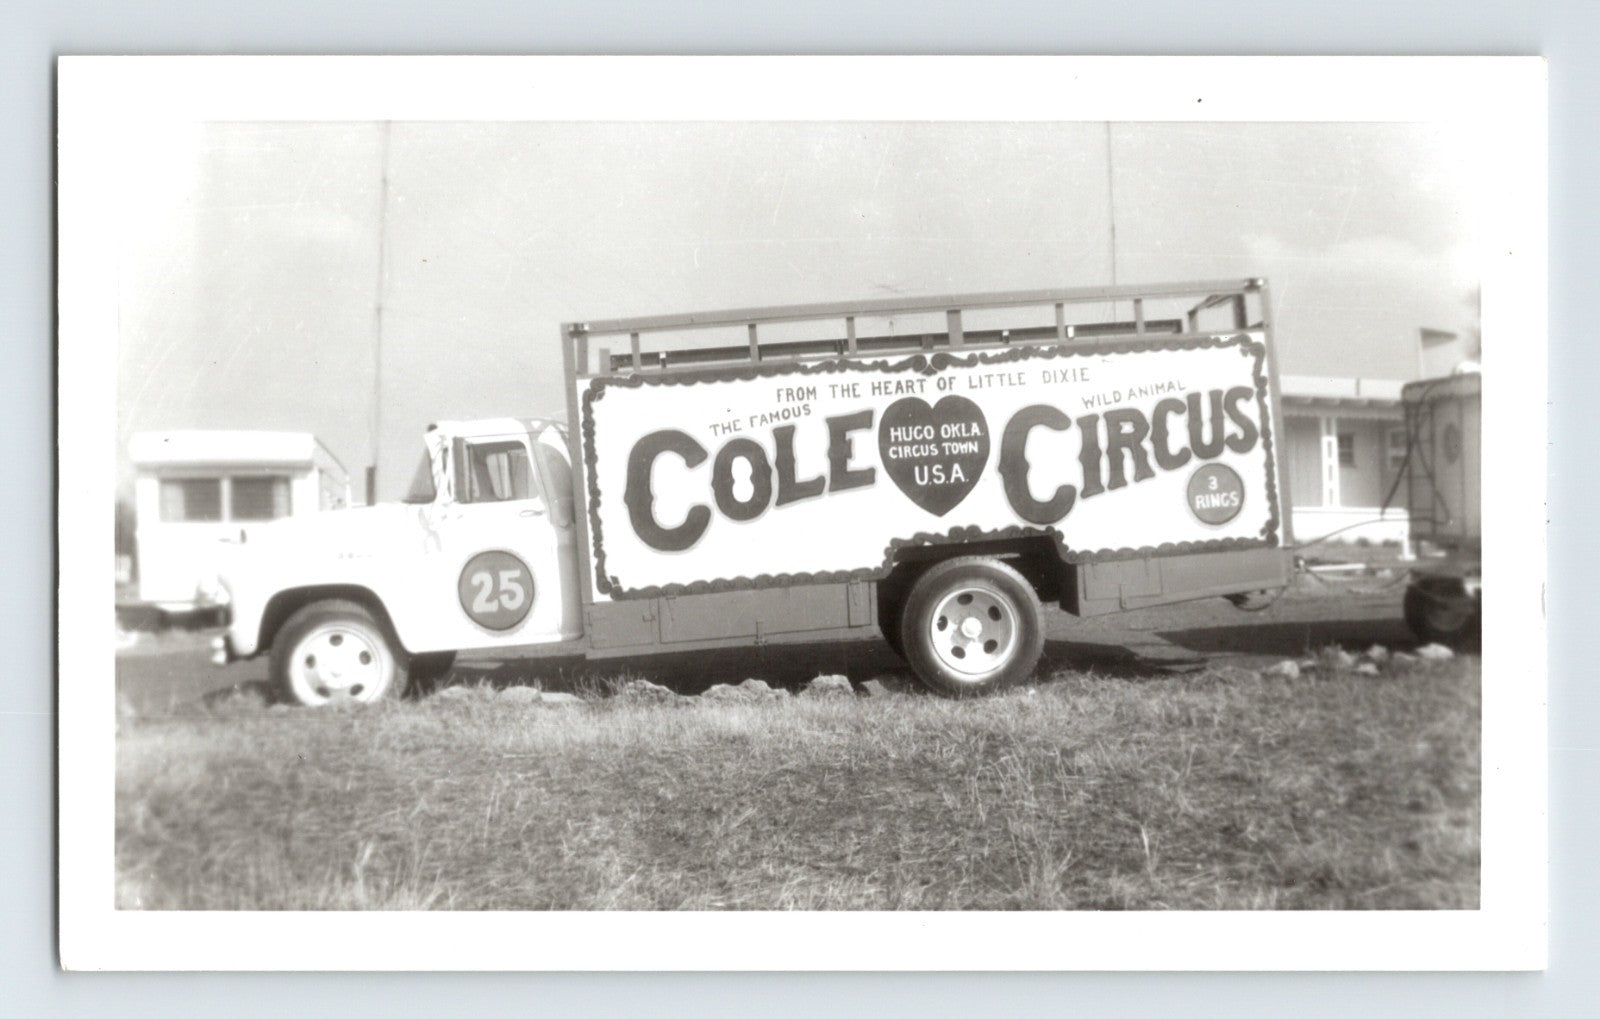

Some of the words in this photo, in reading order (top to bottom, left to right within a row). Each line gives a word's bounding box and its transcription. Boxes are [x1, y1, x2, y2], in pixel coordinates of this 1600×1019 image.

[777, 386, 817, 402] FROM
[829, 383, 861, 398] THE
[871, 379, 927, 396] HEART
[937, 376, 956, 391] OF
[968, 372, 1026, 389] LITTLE
[1042, 367, 1090, 384] DIXIE
[1082, 390, 1122, 409] WILD
[1128, 380, 1187, 400] ANIMAL
[709, 419, 742, 437] THE
[750, 403, 812, 428] FAMOUS
[889, 444, 938, 459] CIRCUS
[942, 441, 979, 455] TOWN
[999, 386, 1259, 525] CIRCUS
[624, 408, 877, 553] COLE
[1208, 476, 1218, 490] 3
[1195, 491, 1239, 509] RINGS
[471, 569, 525, 613] 25
